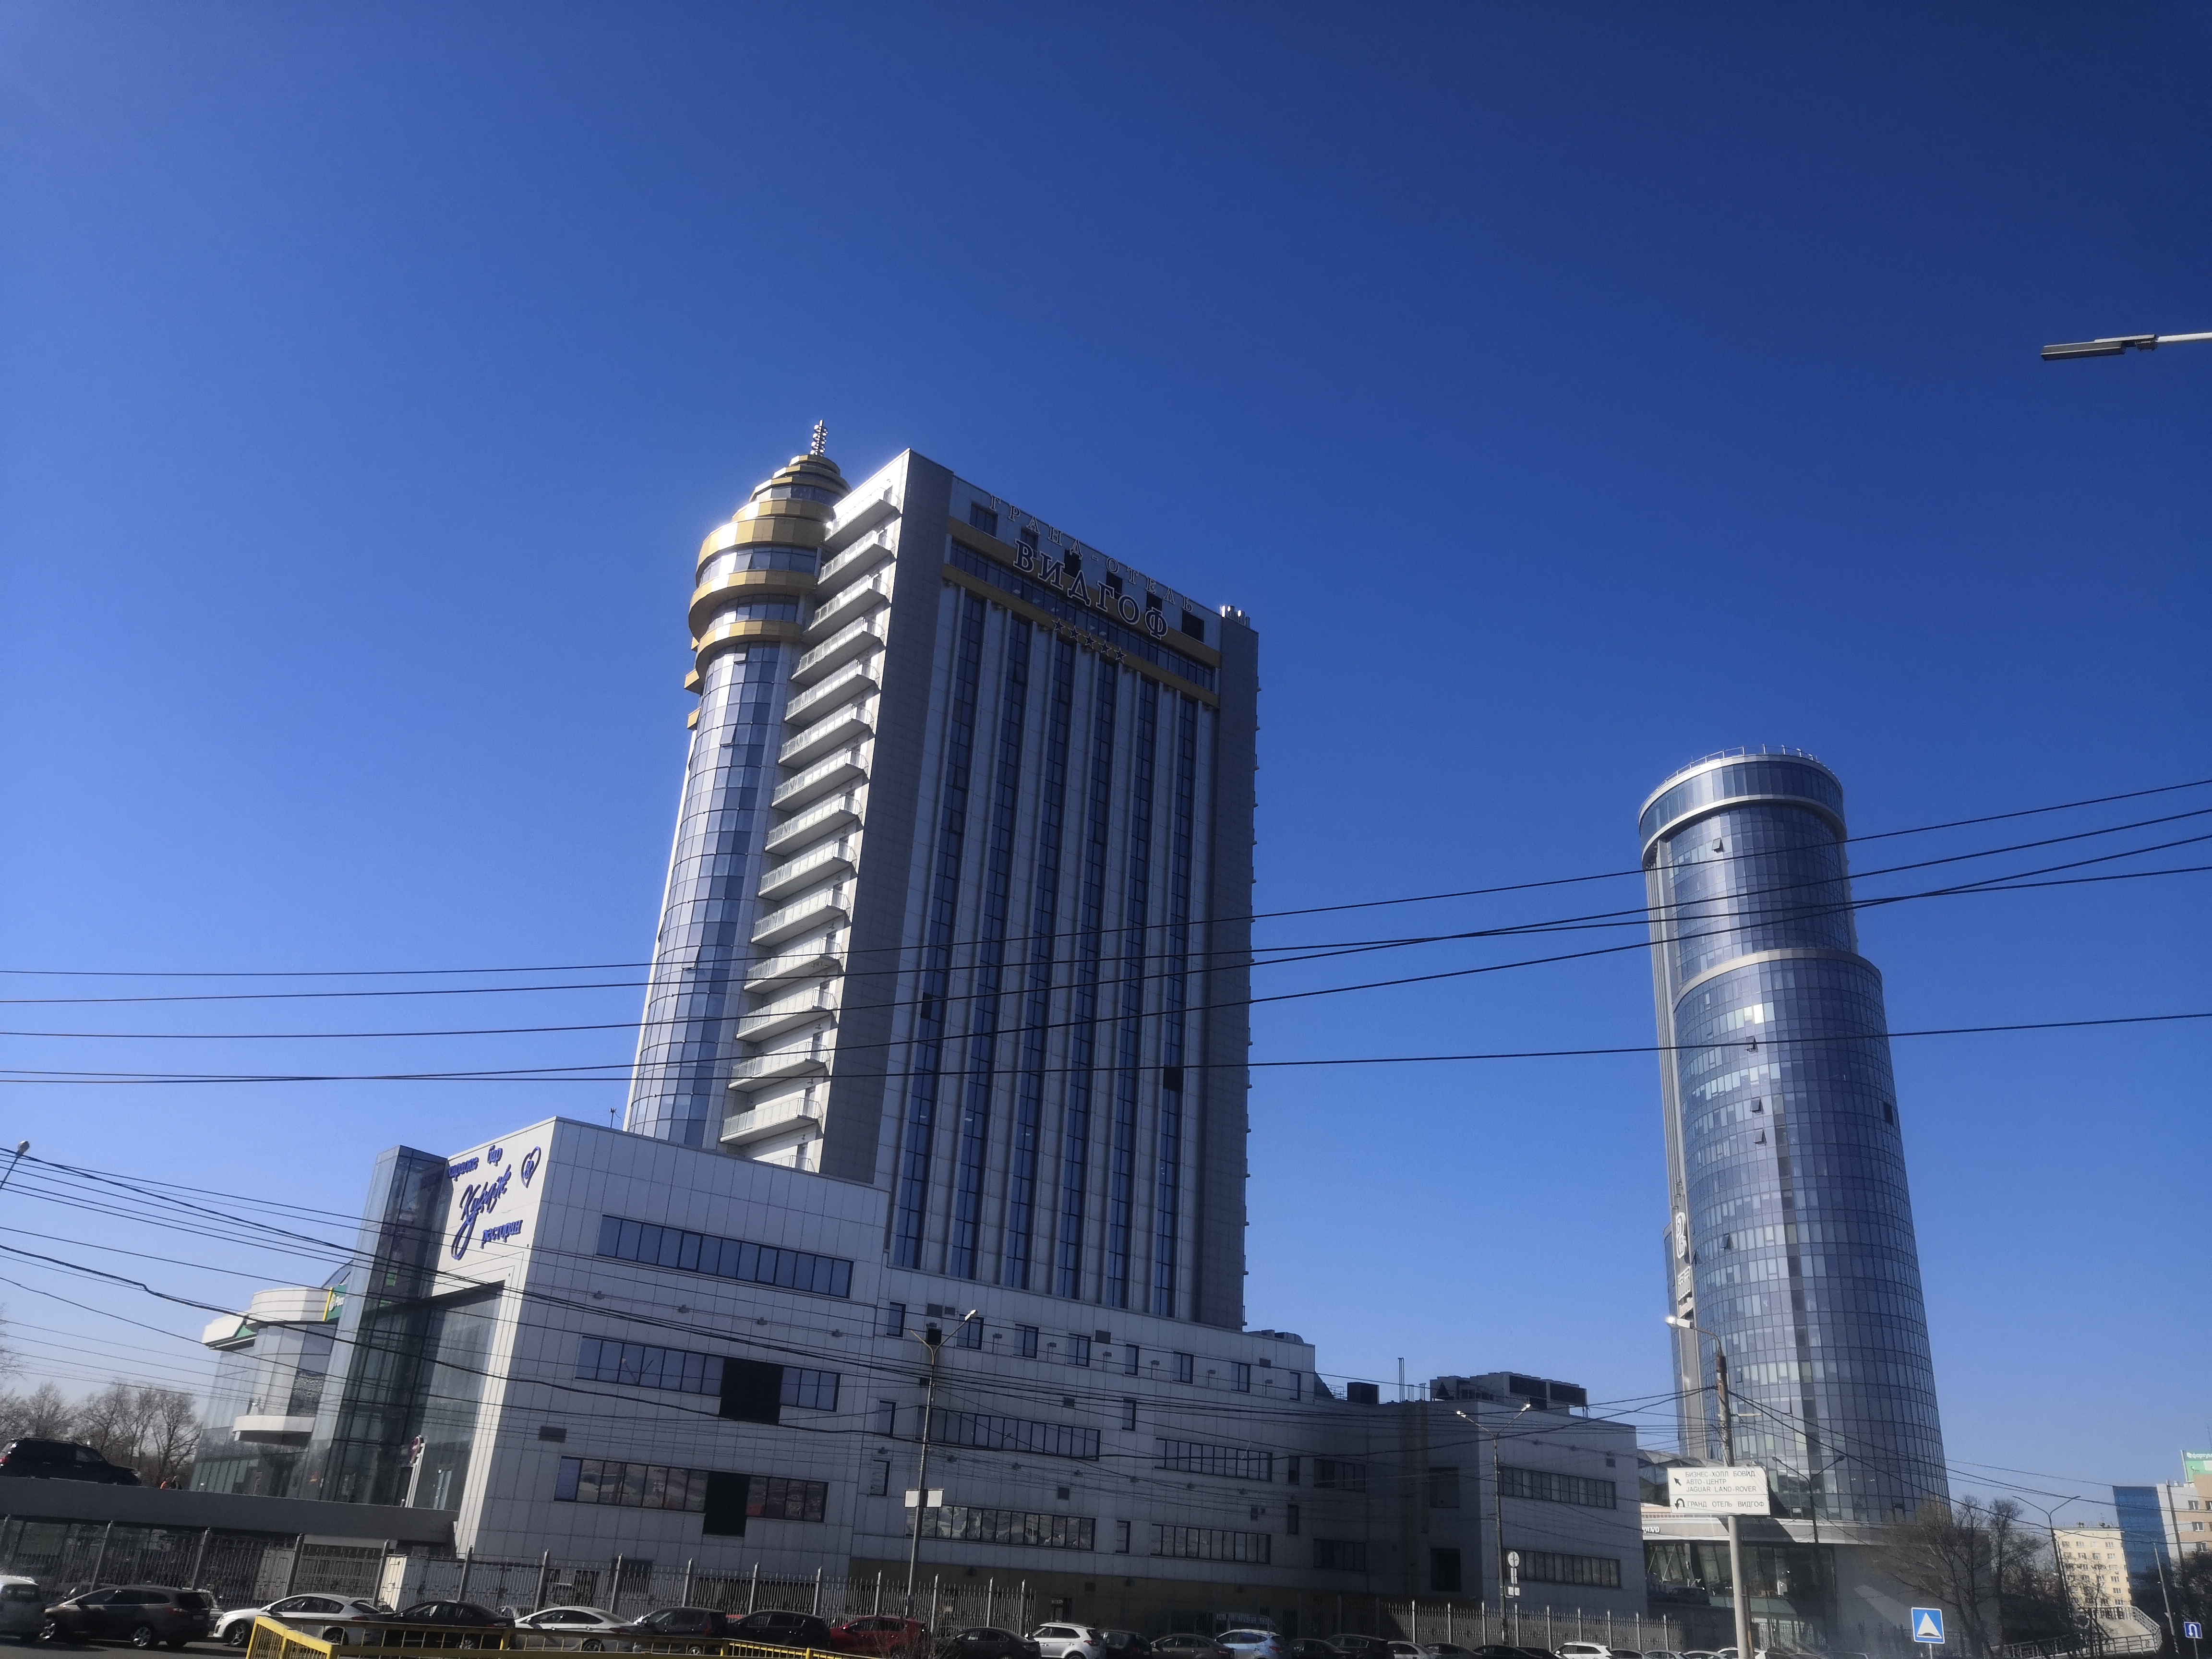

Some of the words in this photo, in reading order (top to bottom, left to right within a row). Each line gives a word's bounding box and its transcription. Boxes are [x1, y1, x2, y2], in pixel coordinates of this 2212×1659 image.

[989, 494, 1193, 613] ГРАНД-ОТЕЛЬ
[1013, 538, 1168, 640] ВИДГОФ
[487, 1144, 503, 1167] бар
[480, 1219, 523, 1250] ресторан
